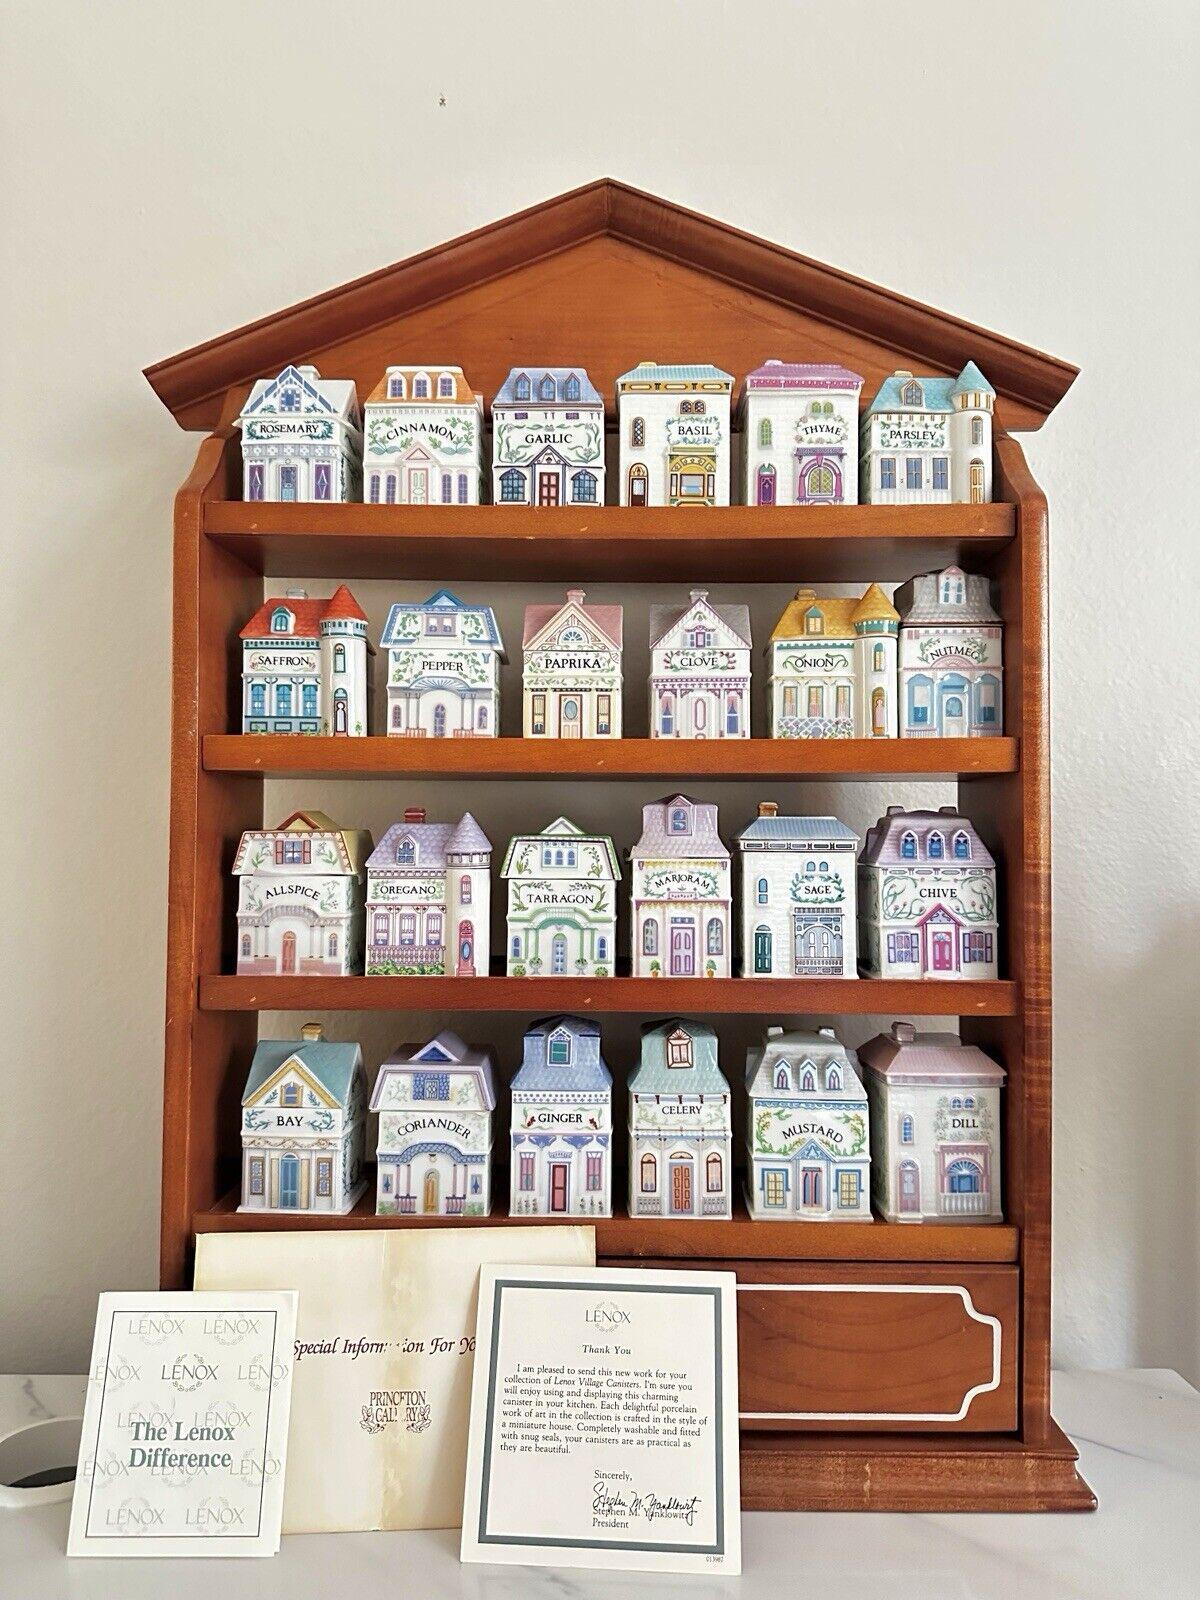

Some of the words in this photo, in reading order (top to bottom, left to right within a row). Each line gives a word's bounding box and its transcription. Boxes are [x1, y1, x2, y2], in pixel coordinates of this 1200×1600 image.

[260, 423, 319, 434] ROSEMARY
[386, 423, 456, 441] CINNAMON
[678, 425, 712, 436] BASIL
[803, 424, 842, 436] THYME
[525, 432, 573, 445] GARLIC
[889, 431, 937, 441] PARSLEY
[258, 655, 310, 666] SAFFRON
[422, 661, 463, 672] PEPPER
[544, 657, 601, 668] PAPRIKA
[681, 657, 718, 666] CLOVE
[793, 657, 834, 669] ONION
[655, 874, 710, 889] MARJORAM
[265, 884, 320, 901] ALLSPICE
[380, 886, 436, 894] OREGANO
[804, 884, 832, 895] SAGE
[919, 887, 957, 899] CHIVE
[526, 892, 594, 904] TARRAGON
[662, 1104, 702, 1115] CELERY
[277, 1115, 304, 1128] BAY
[538, 1112, 583, 1123] GINGER
[952, 1118, 979, 1128] DILL
[397, 1118, 471, 1139] CORIANDER
[782, 1123, 843, 1143] MUSTARD
[585, 1309, 631, 1323] LENOX
[128, 1319, 185, 1335] LENOX
[203, 1319, 260, 1335] LENOX
[294, 1337, 340, 1361] Special
[342, 1337, 424, 1360] Informion
[430, 1337, 455, 1354] For
[459, 1336, 476, 1354] Yo
[582, 1344, 610, 1354] Thank
[614, 1346, 631, 1354] You
[161, 1365, 219, 1380] LENOX
[537, 1365, 564, 1374] pleased
[578, 1367, 595, 1375] send
[598, 1367, 612, 1376] this
[634, 1369, 652, 1377] work
[656, 1369, 666, 1378] for
[504, 1375, 540, 1384] collection
[544, 1376, 552, 1384] of
[554, 1377, 575, 1385] Lenox
[579, 1378, 603, 1388] Village
[607, 1379, 641, 1388] Canisters.
[645, 1380, 656, 1389] I'm
[504, 1386, 517, 1394] will
[544, 1388, 563, 1398] using
[584, 1389, 622, 1400] displaying
[625, 1391, 639, 1399] this
[642, 1392, 678, 1403] charming
[567, 1399, 597, 1408] kitchen.
[601, 1401, 619, 1410] Each
[623, 1402, 658, 1412] delightful
[662, 1404, 697, 1413] porcelain
[117, 1412, 175, 1428] LENOX
[194, 1411, 252, 1427] LENOX
[503, 1408, 521, 1416] work
[525, 1409, 533, 1417] of
[560, 1410, 572, 1419] the
[575, 1411, 611, 1421] collection
[624, 1413, 650, 1422] crafted
[653, 1415, 660, 1423] in
[664, 1415, 676, 1423] the
[680, 1416, 696, 1425] style
[699, 1417, 707, 1425] of
[131, 1421, 167, 1441] The
[174, 1422, 236, 1441] Lenox
[549, 1421, 573, 1430] house.
[577, 1422, 621, 1434] Completely
[625, 1425, 659, 1434] washable
[662, 1427, 677, 1435] and
[680, 1427, 700, 1436] fitted
[501, 1431, 518, 1439] with
[521, 1434, 539, 1442] snug
[542, 1433, 561, 1442] seals,
[586, 1436, 619, 1444] canisters
[647, 1438, 680, 1447] practical
[501, 1442, 517, 1451] they
[535, 1444, 570, 1453] beautiful.
[129, 1448, 231, 1468] Difference
[82, 1459, 129, 1476] ENOX
[594, 1470, 632, 1481] Sincerely,
[106, 1509, 166, 1525] LENOX
[185, 1508, 245, 1525] LENOX
[593, 1507, 625, 1517] Stephen
[629, 1508, 640, 1516] M.
[593, 1518, 629, 1528] President
